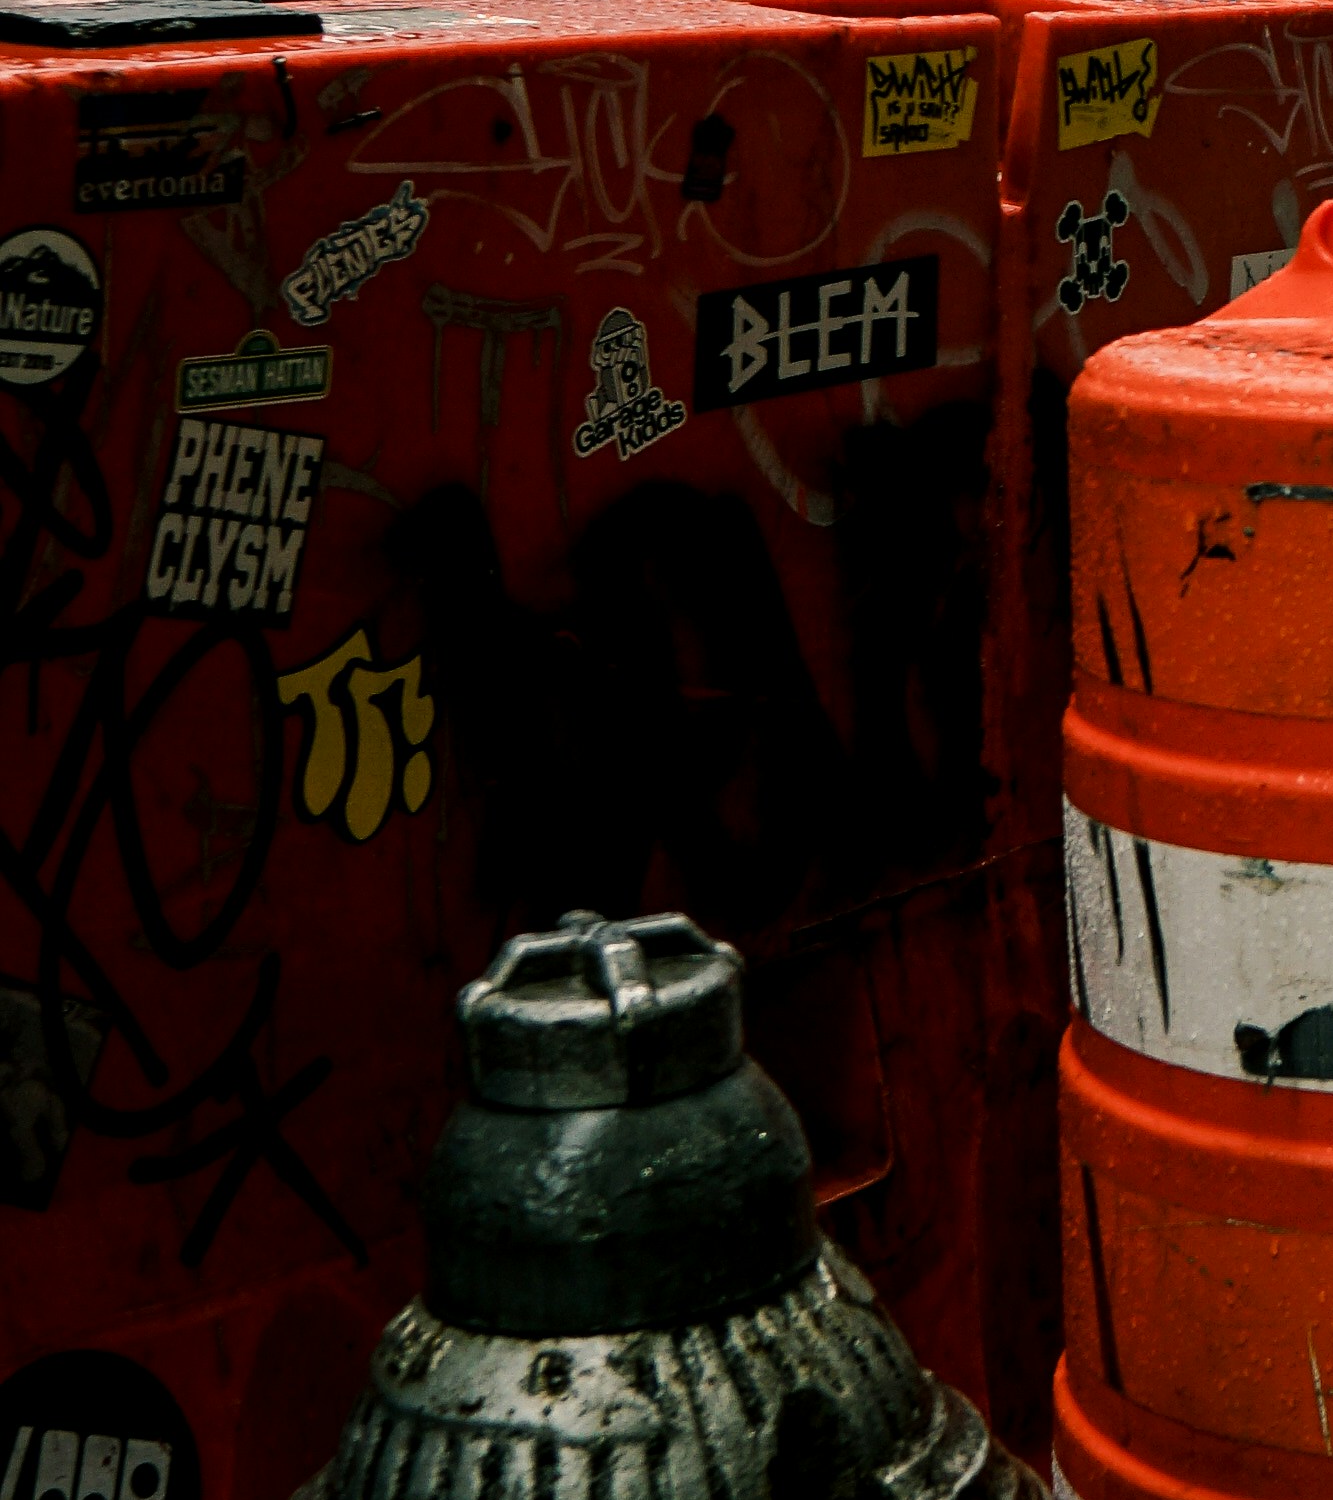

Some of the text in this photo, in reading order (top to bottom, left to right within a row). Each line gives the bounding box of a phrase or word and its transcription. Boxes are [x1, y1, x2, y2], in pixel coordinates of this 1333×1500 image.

[719, 271, 919, 394] BLEM
[163, 417, 326, 524] PHENE
[575, 389, 661, 453] Garage
[147, 511, 306, 616] CLYSM
